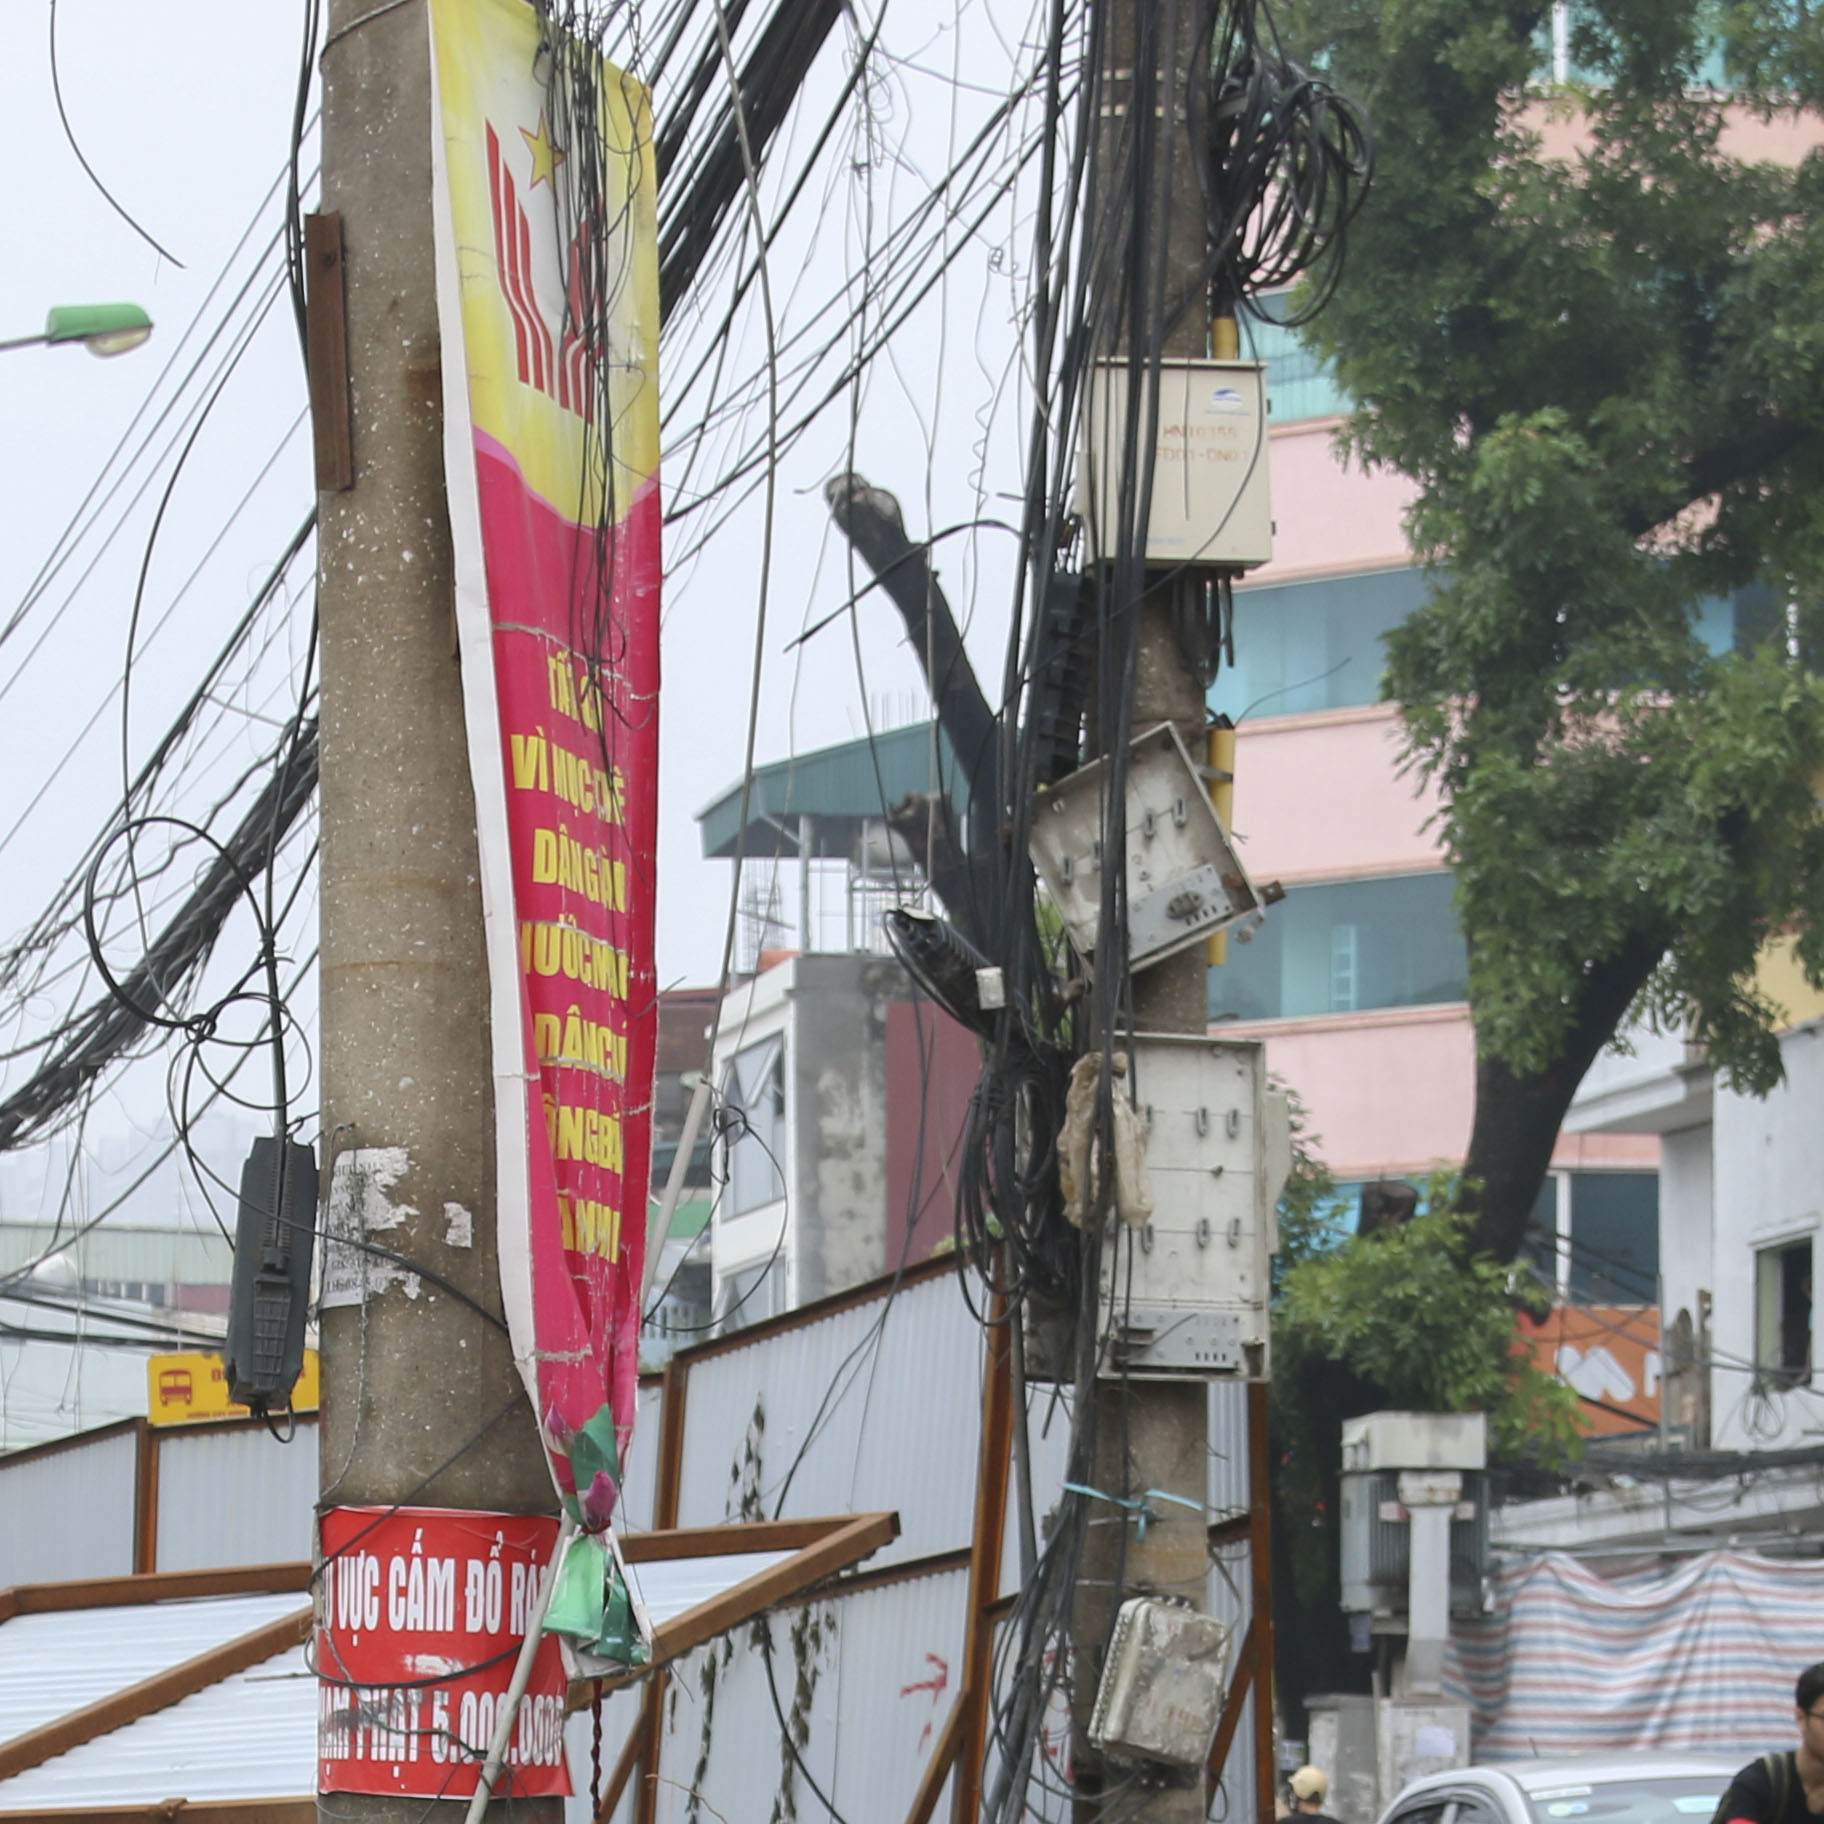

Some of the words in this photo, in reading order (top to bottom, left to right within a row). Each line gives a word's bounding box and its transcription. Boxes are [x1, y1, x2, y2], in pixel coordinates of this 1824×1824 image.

[510, 725, 549, 793] VÌ
[551, 743, 593, 817] MỤC
[593, 766, 626, 826] TIÊ
[532, 823, 585, 896] DÂN
[592, 941, 629, 1008] MẠN
[534, 1005, 597, 1075] DÂN
[541, 1093, 596, 1164] ÔNG
[337, 1549, 380, 1647] VỰC
[388, 1528, 456, 1632] CẤM
[464, 1530, 503, 1635] ĐỔ
